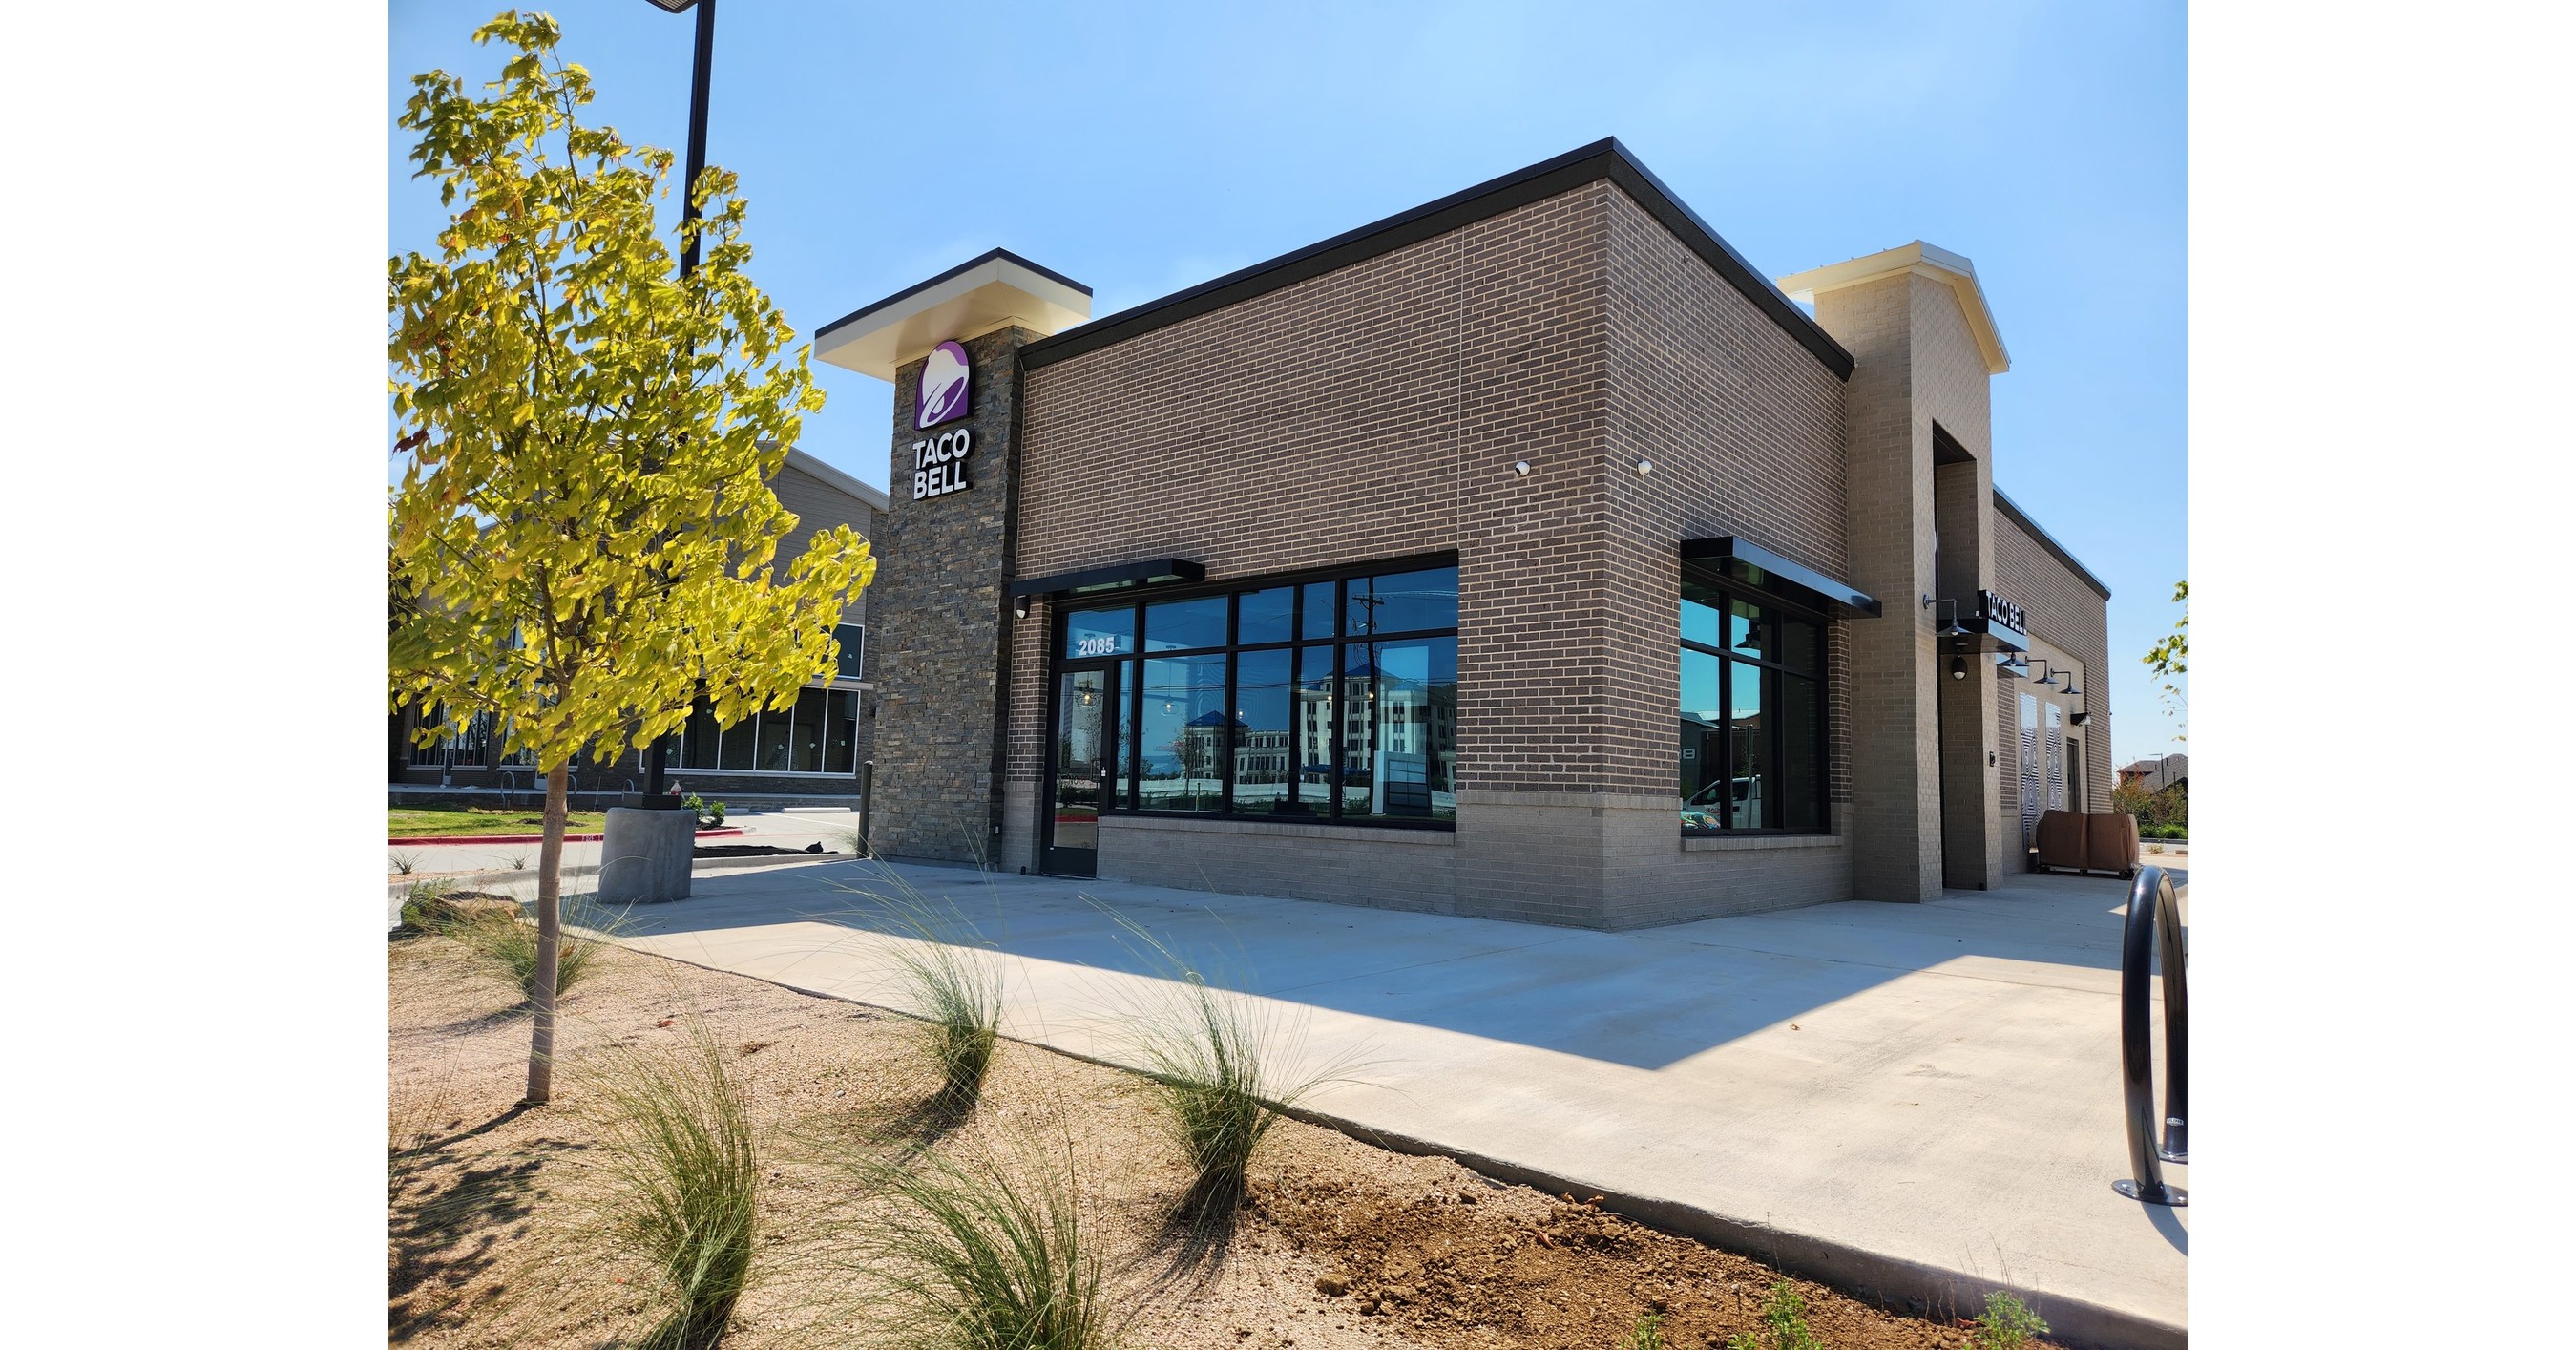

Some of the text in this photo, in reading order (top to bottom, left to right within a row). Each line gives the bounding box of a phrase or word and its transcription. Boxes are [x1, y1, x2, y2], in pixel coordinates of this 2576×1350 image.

[912, 428, 971, 470] TACO
[913, 460, 968, 500] BELL
[1986, 590, 2027, 636] TACO BELL
[1079, 636, 1115, 656] 2085
